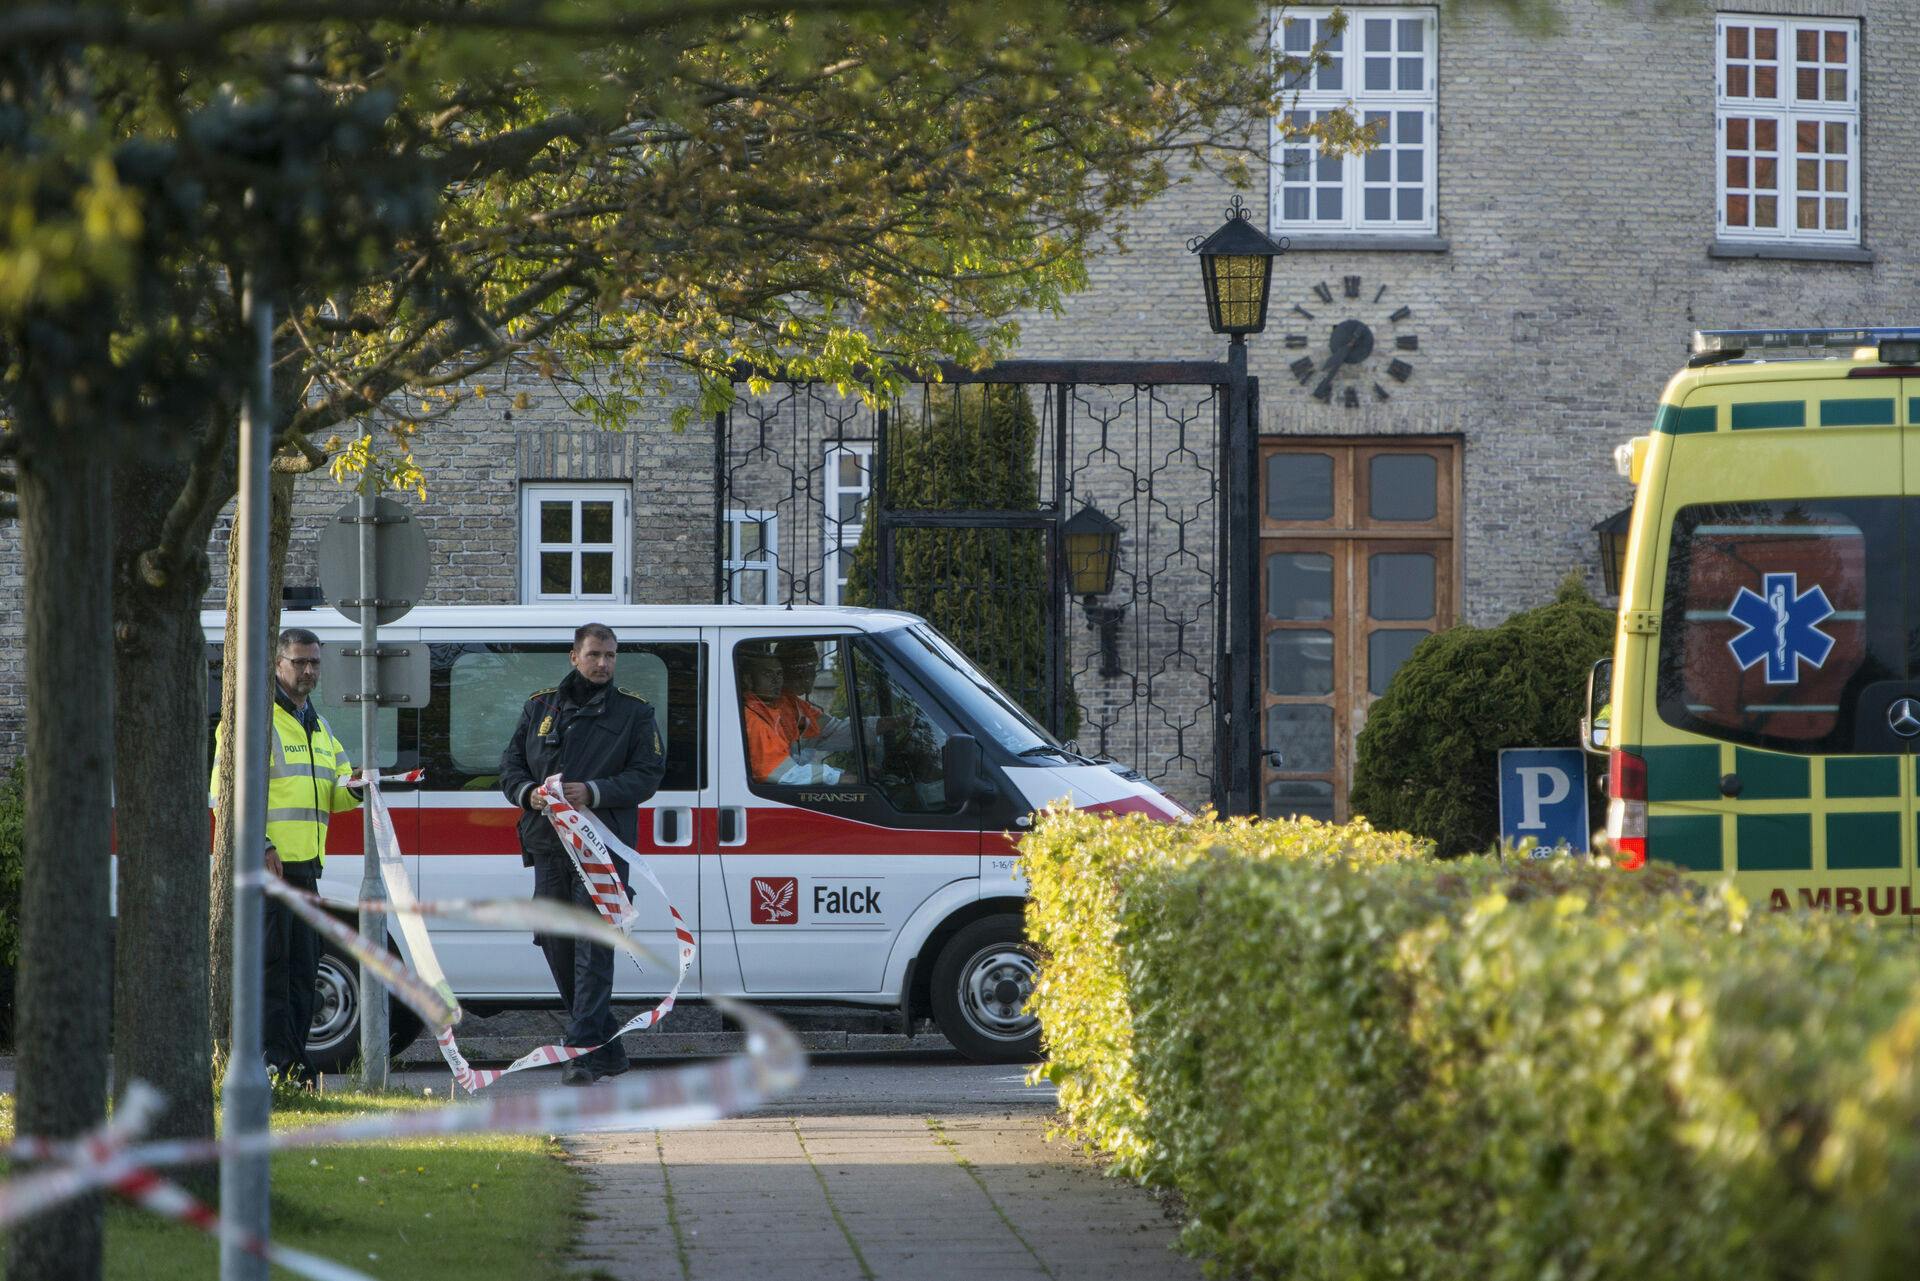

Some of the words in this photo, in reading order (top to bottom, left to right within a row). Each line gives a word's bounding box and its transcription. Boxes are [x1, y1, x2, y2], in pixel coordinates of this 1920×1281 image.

[284, 744, 307, 753] POLITI
[798, 792, 868, 802] TRANSIT
[1516, 766, 1571, 830] P
[581, 824, 607, 855] POLITI
[813, 885, 882, 914] Falck
[1769, 886, 1920, 917] AMBUL
